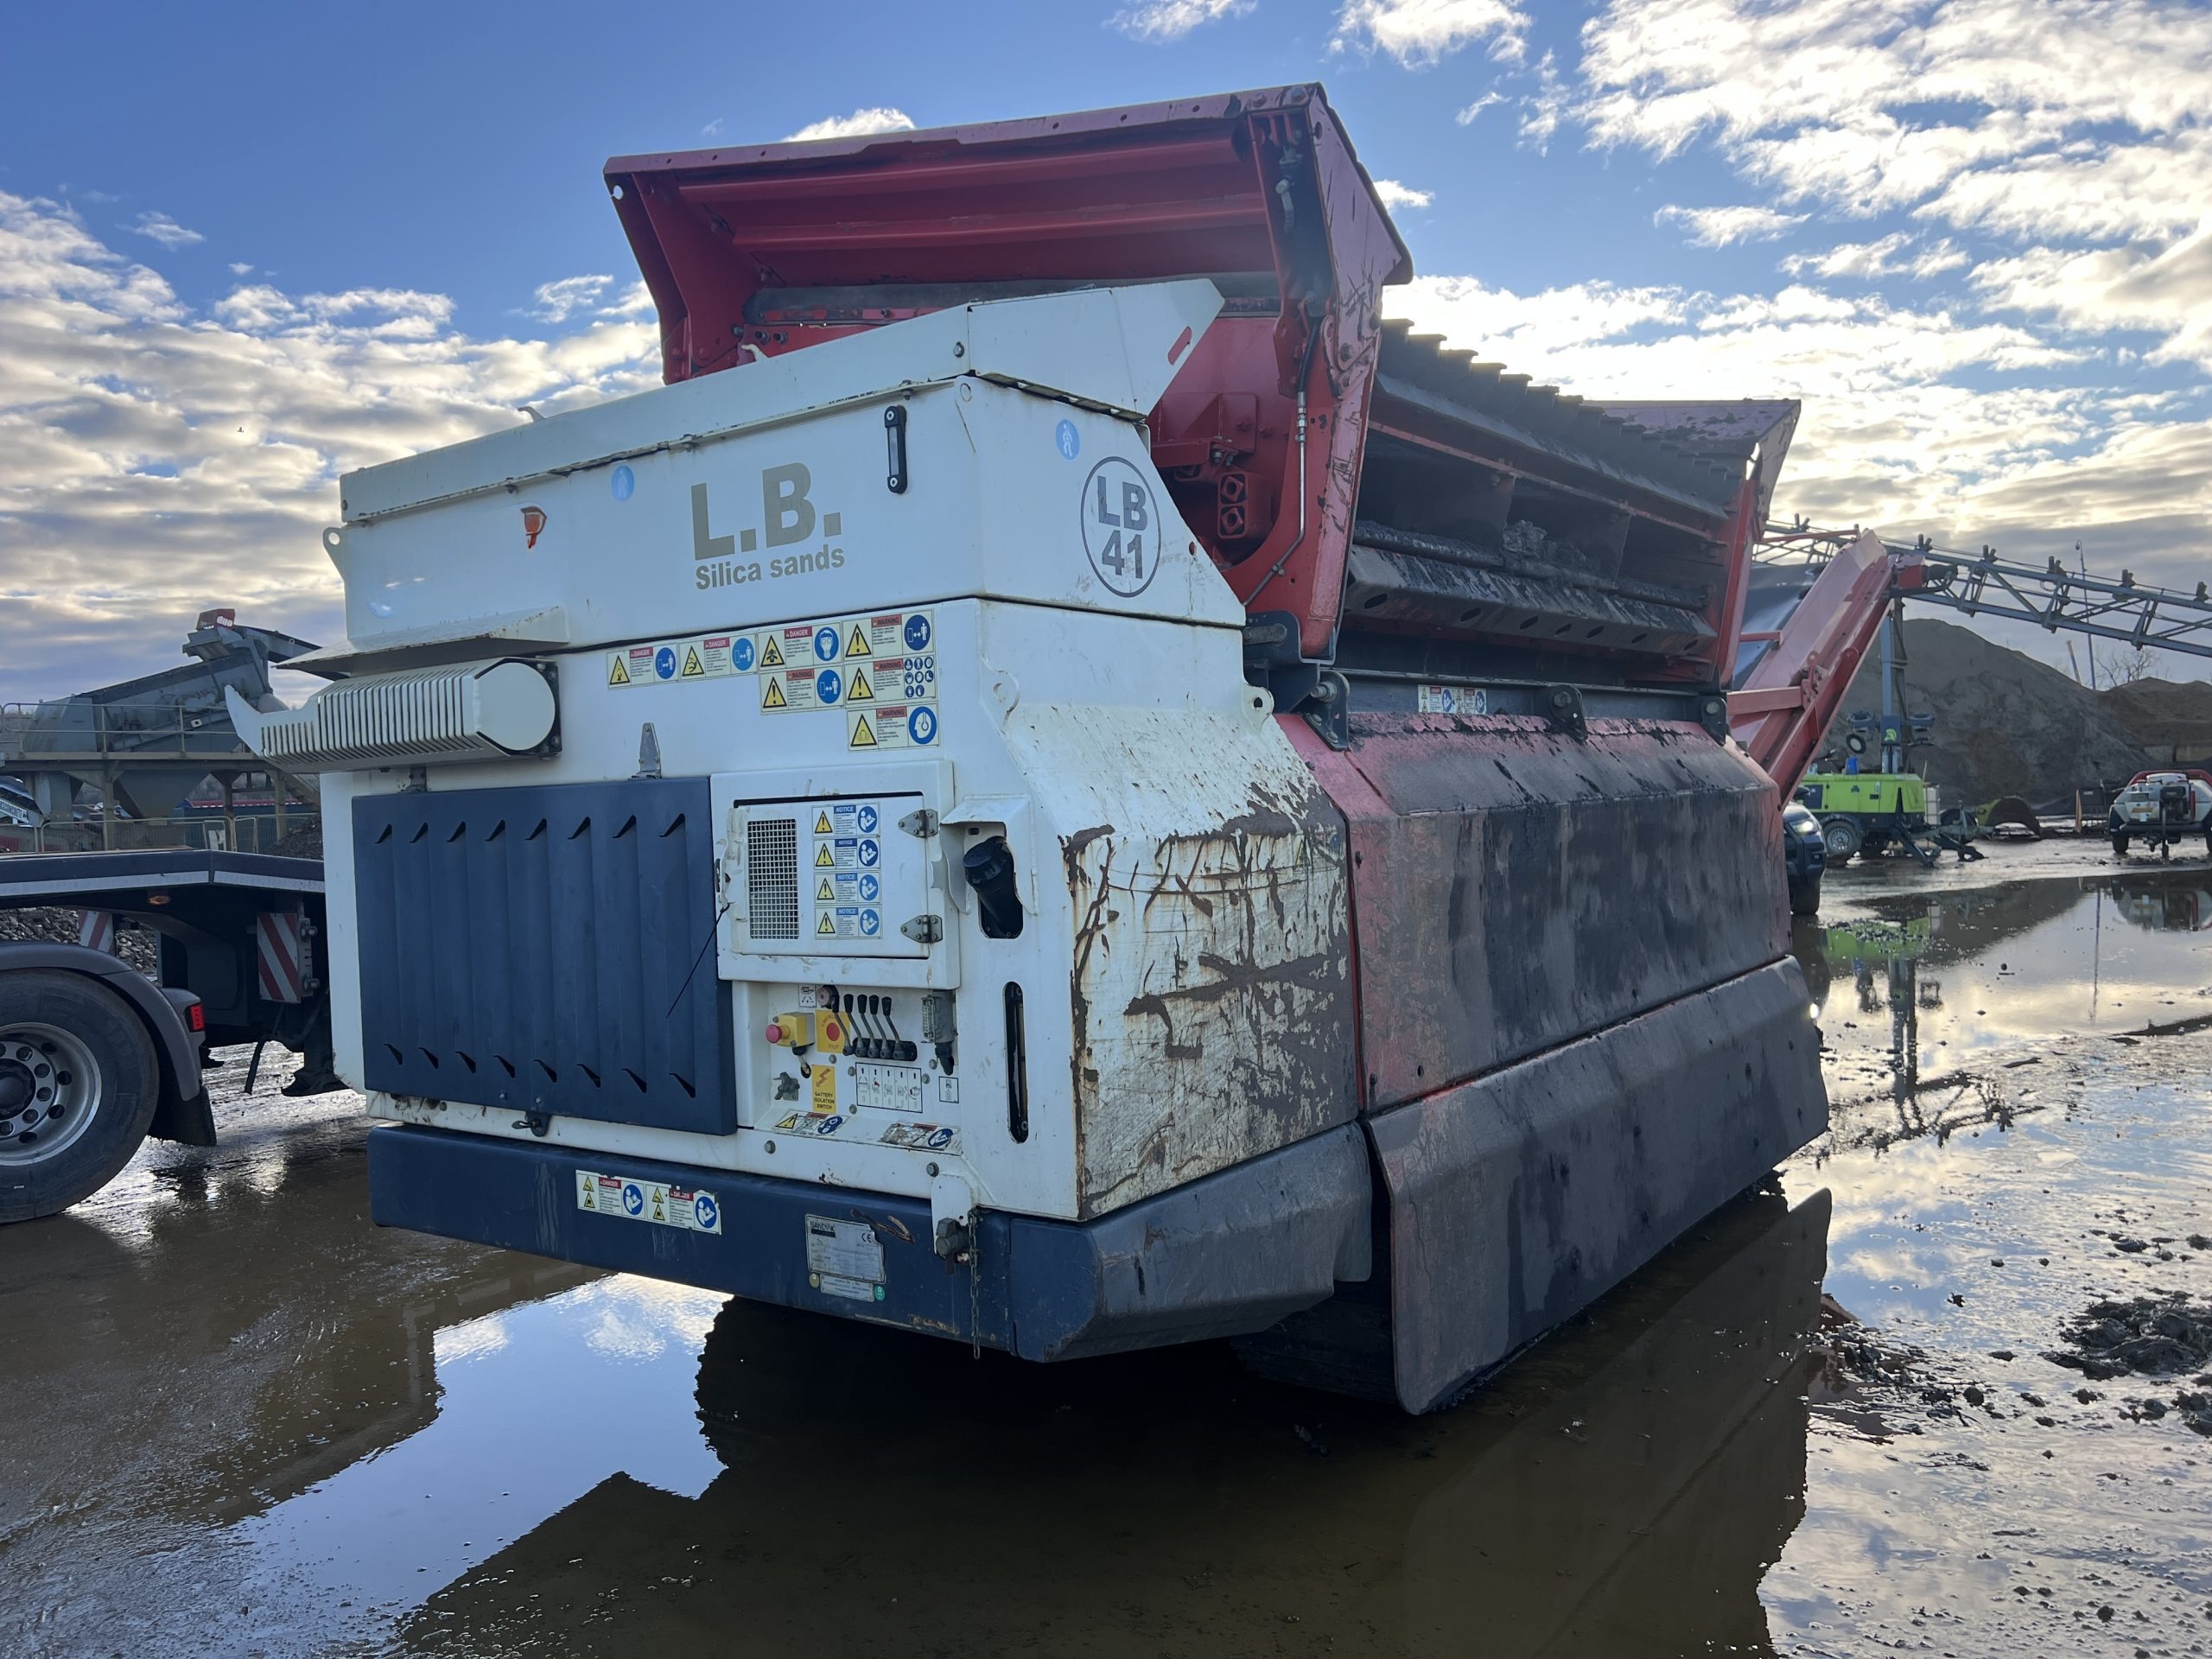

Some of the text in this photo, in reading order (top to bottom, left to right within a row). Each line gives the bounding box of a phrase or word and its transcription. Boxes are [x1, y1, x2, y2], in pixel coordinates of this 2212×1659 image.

[690, 462, 842, 561] L.B.
[1097, 475, 1148, 531] LB
[696, 543, 845, 590] Silica sands
[1102, 530, 1143, 579] 41
[877, 616, 899, 625] WARNING
[879, 660, 901, 669] WARNING
[882, 708, 905, 716] WARNING
[810, 1222, 835, 1231] SANDVIK
